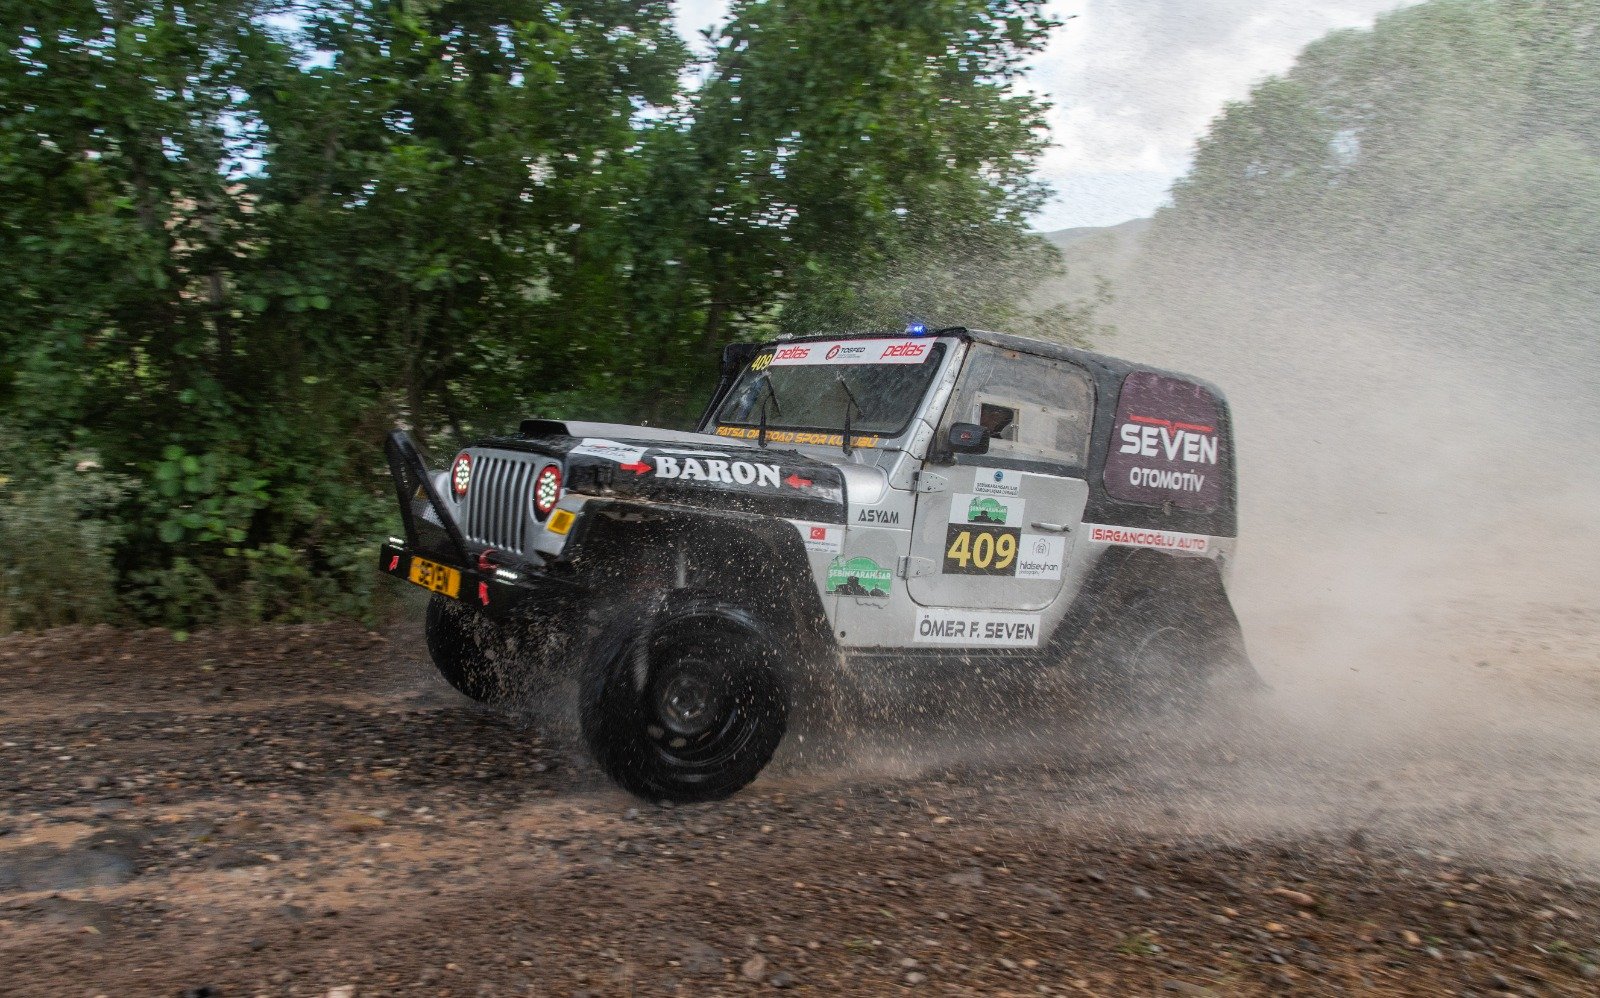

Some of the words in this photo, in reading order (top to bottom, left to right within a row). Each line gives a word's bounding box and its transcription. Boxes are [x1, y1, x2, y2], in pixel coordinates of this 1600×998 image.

[880, 342, 927, 360] petlas
[751, 353, 774, 372] 409
[715, 426, 744, 438] FATSA
[794, 432, 828, 445] SPOR
[1119, 423, 1218, 465] SEVEN
[653, 456, 781, 489] BARON
[1129, 466, 1205, 493] OTOMOTİV
[858, 508, 900, 524] ASYAM
[947, 530, 1017, 570] 409
[1176, 536, 1206, 550] AUTO
[919, 614, 966, 638] ÖMER
[969, 621, 980, 639] F.
[984, 621, 1035, 640] SEVEN
